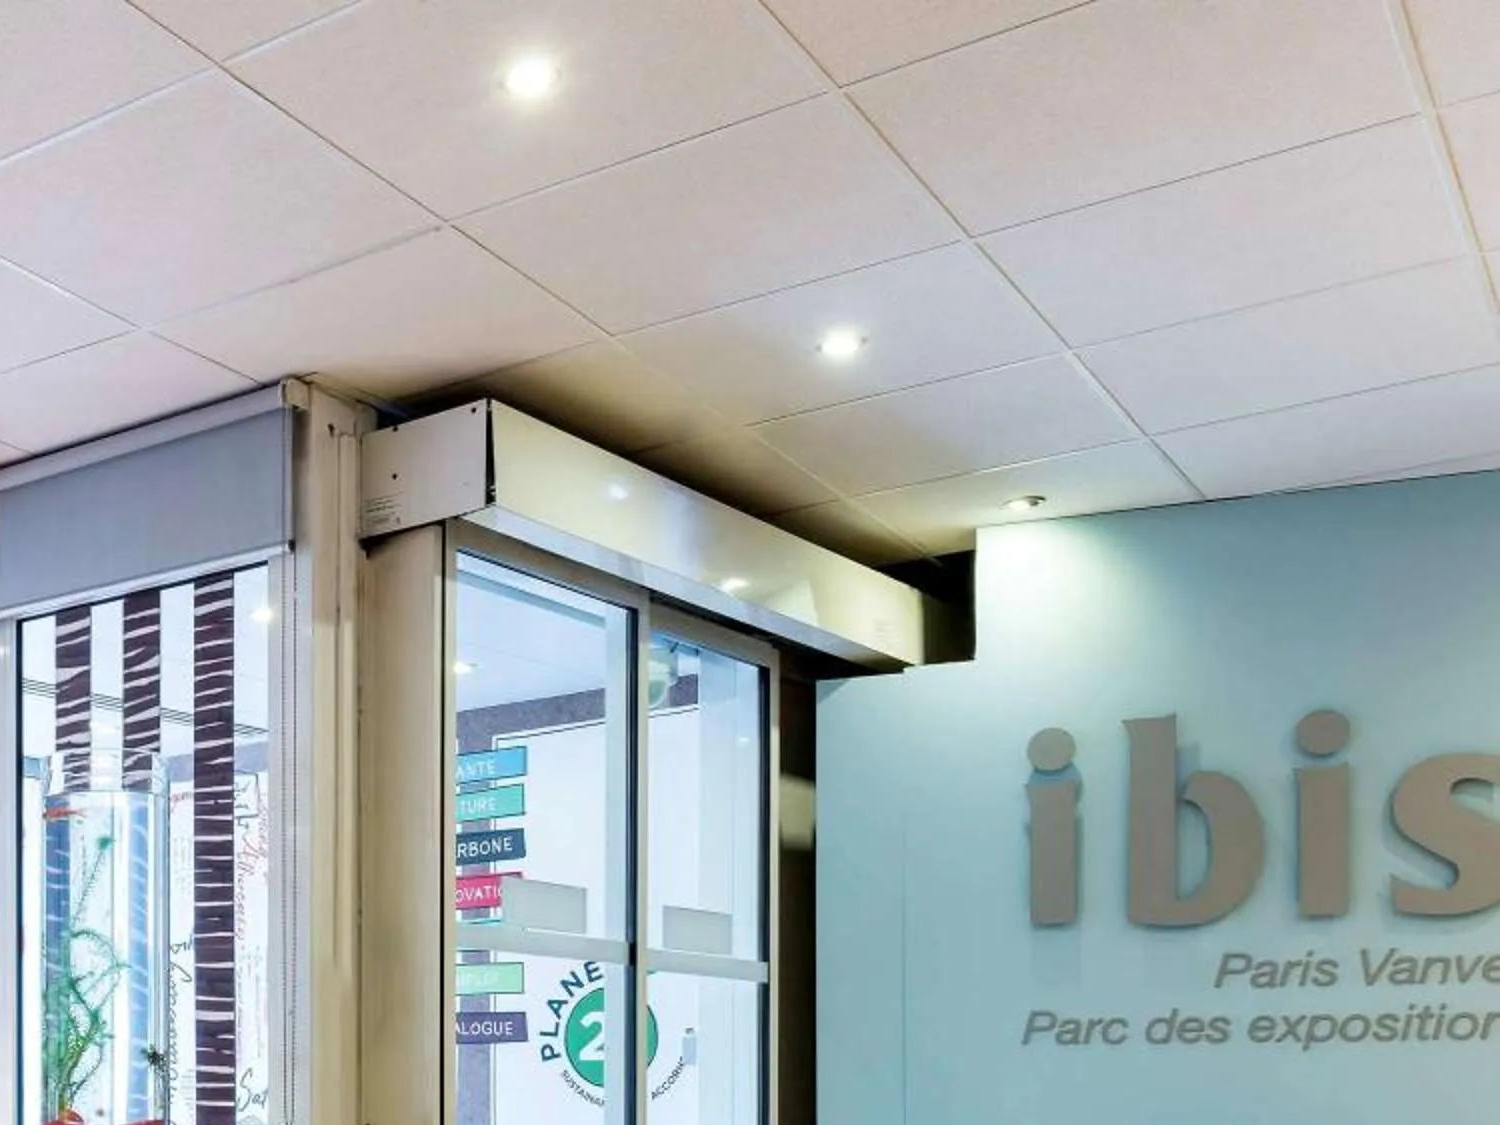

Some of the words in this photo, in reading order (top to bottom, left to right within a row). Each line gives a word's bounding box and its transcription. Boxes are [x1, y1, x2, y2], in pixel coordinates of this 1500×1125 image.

[1024, 708, 1500, 929] ibis
[1213, 951, 1339, 989] Paris
[1359, 947, 1500, 987] Vanve
[1021, 1010, 1128, 1046] Parc
[1144, 1008, 1231, 1045] des
